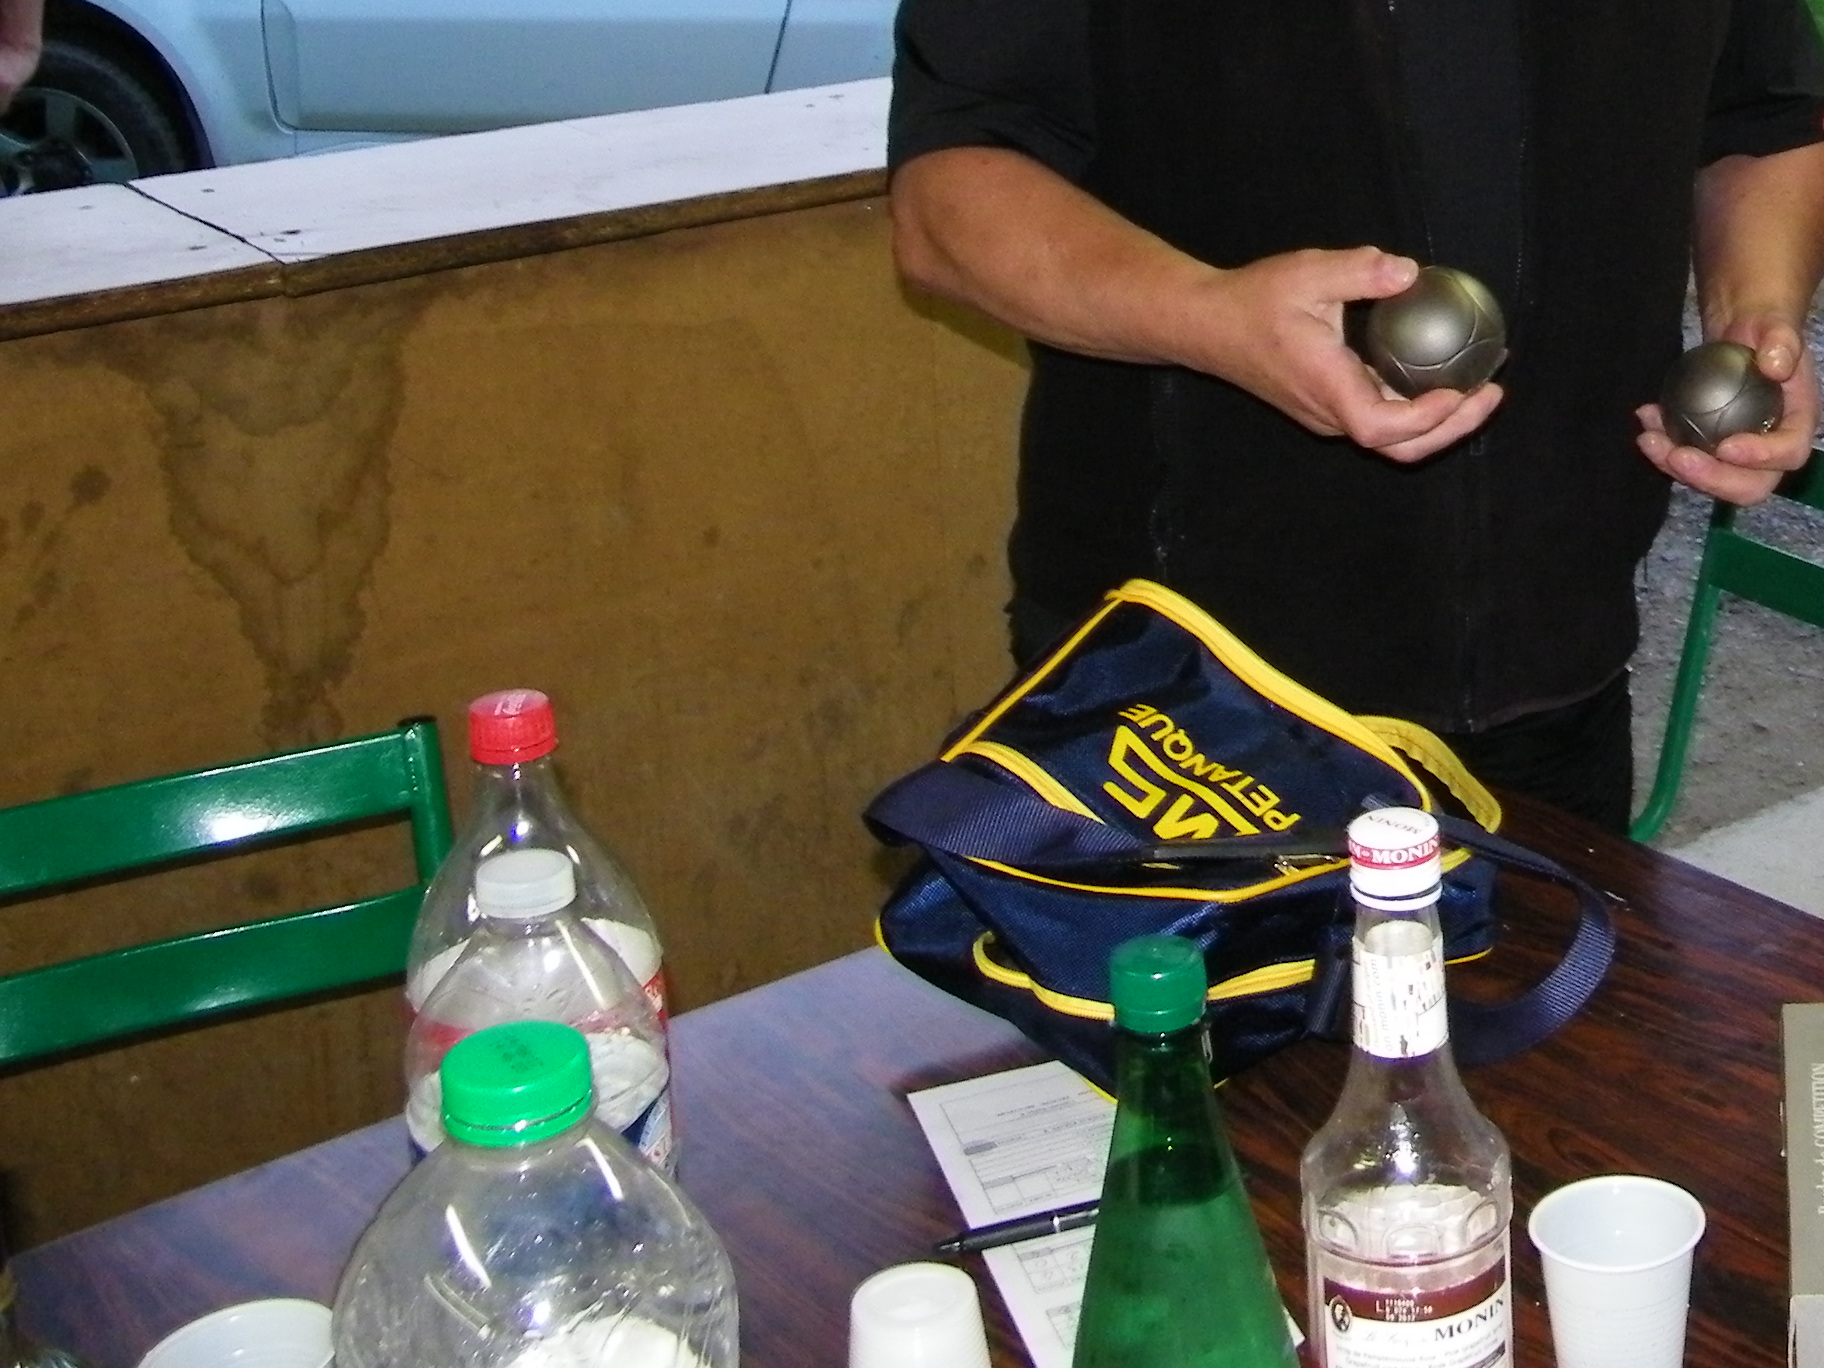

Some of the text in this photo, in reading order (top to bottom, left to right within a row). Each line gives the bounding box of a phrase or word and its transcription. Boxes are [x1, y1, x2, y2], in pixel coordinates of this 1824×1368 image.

[1118, 703, 1302, 832] PETANQUE
[1372, 835, 1440, 865] MONIN
[1434, 1296, 1504, 1342] MONIN
